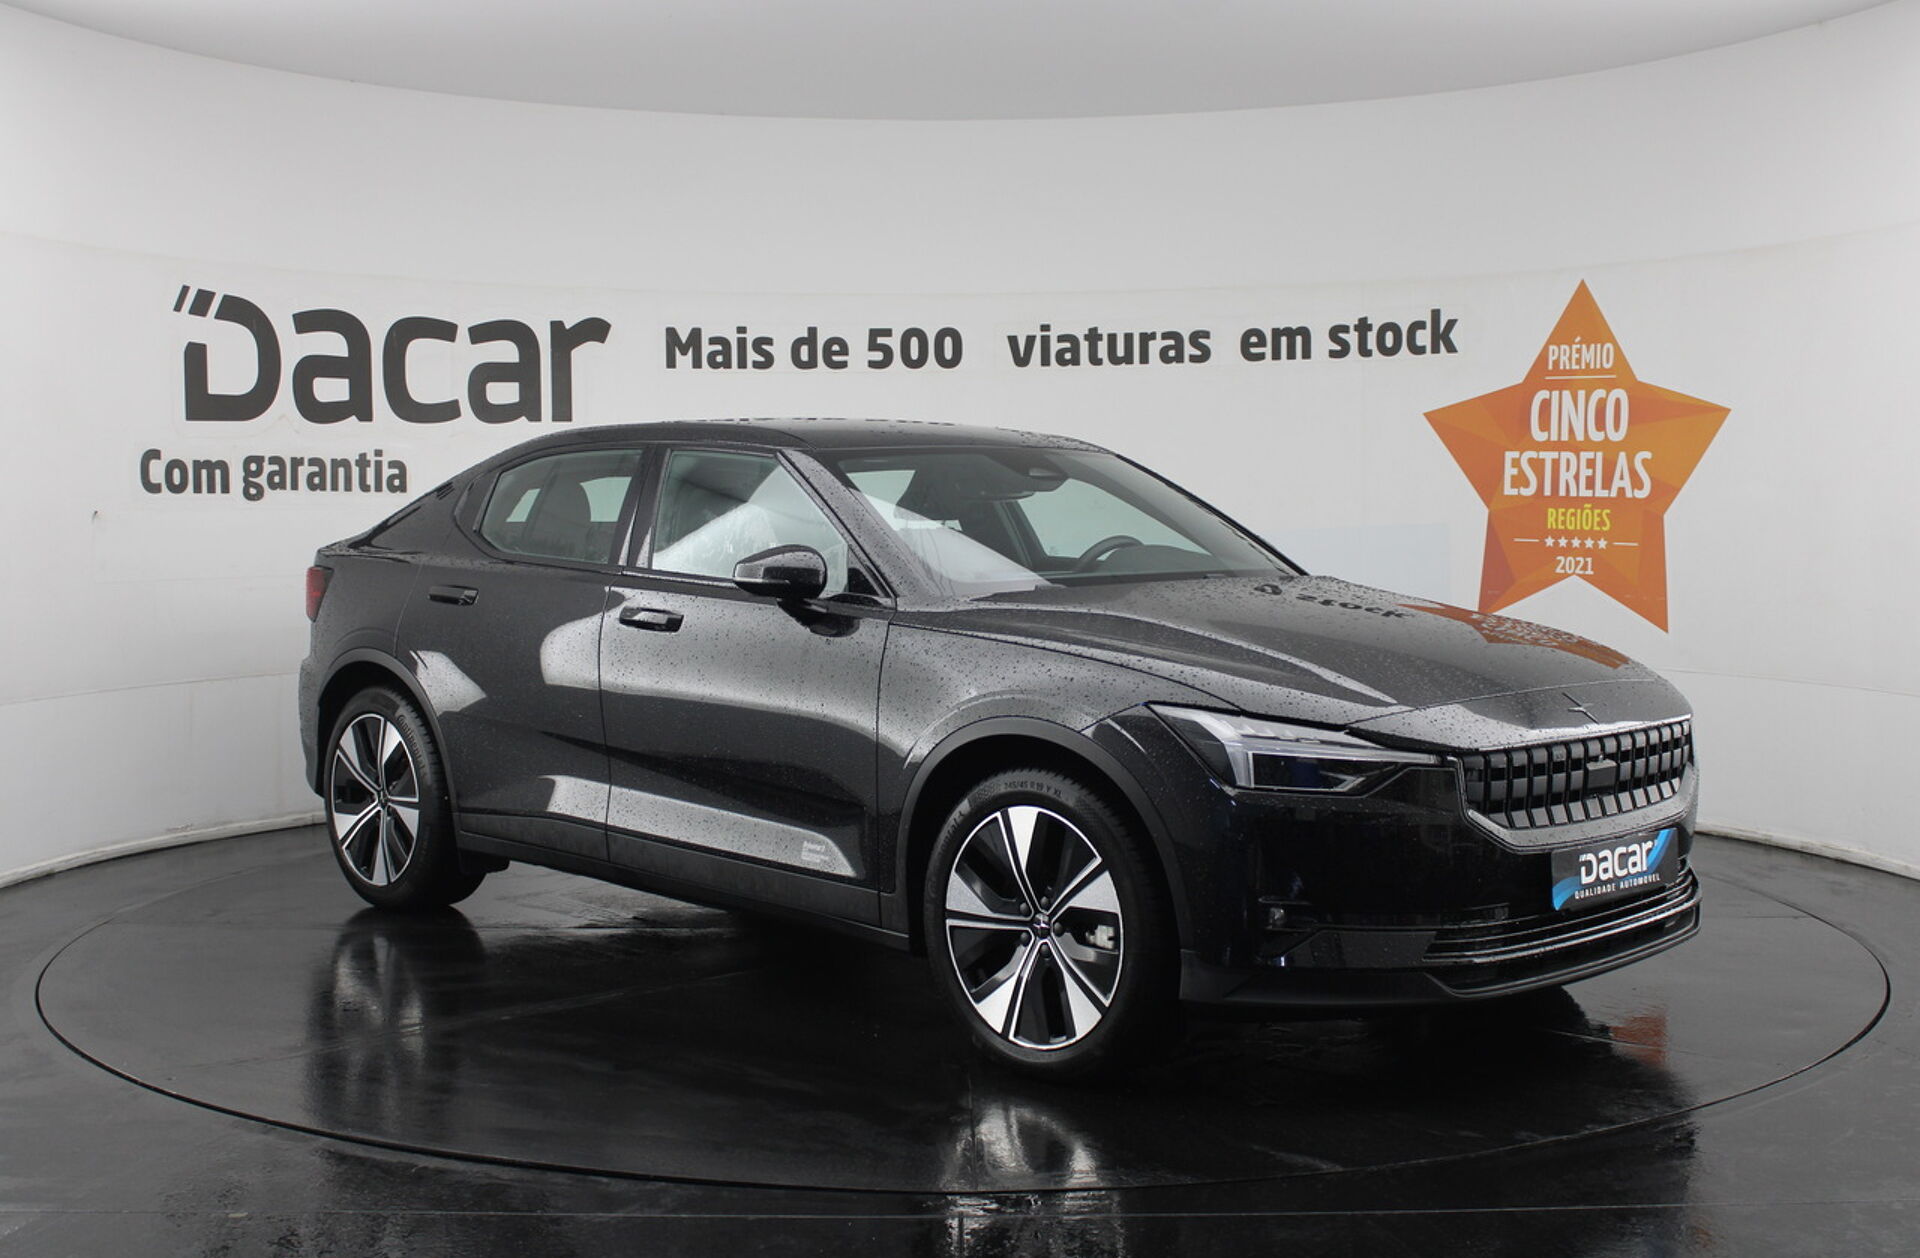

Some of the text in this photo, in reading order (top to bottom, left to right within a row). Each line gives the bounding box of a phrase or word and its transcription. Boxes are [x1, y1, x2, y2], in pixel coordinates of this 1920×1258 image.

[173, 284, 612, 425] Dacar
[665, 308, 1459, 369] Mais de 500 viaturas em stock
[1547, 336, 1615, 371] PRÉMIO
[1530, 388, 1630, 442] CINCO
[140, 448, 409, 502] Com garantia
[1503, 450, 1653, 499] ESTRELAS
[1547, 503, 1611, 531] REGIÕES
[1555, 555, 1594, 575] 2021
[1579, 841, 1653, 884] Dacar
[1575, 884, 1616, 899] QUALIDADE
